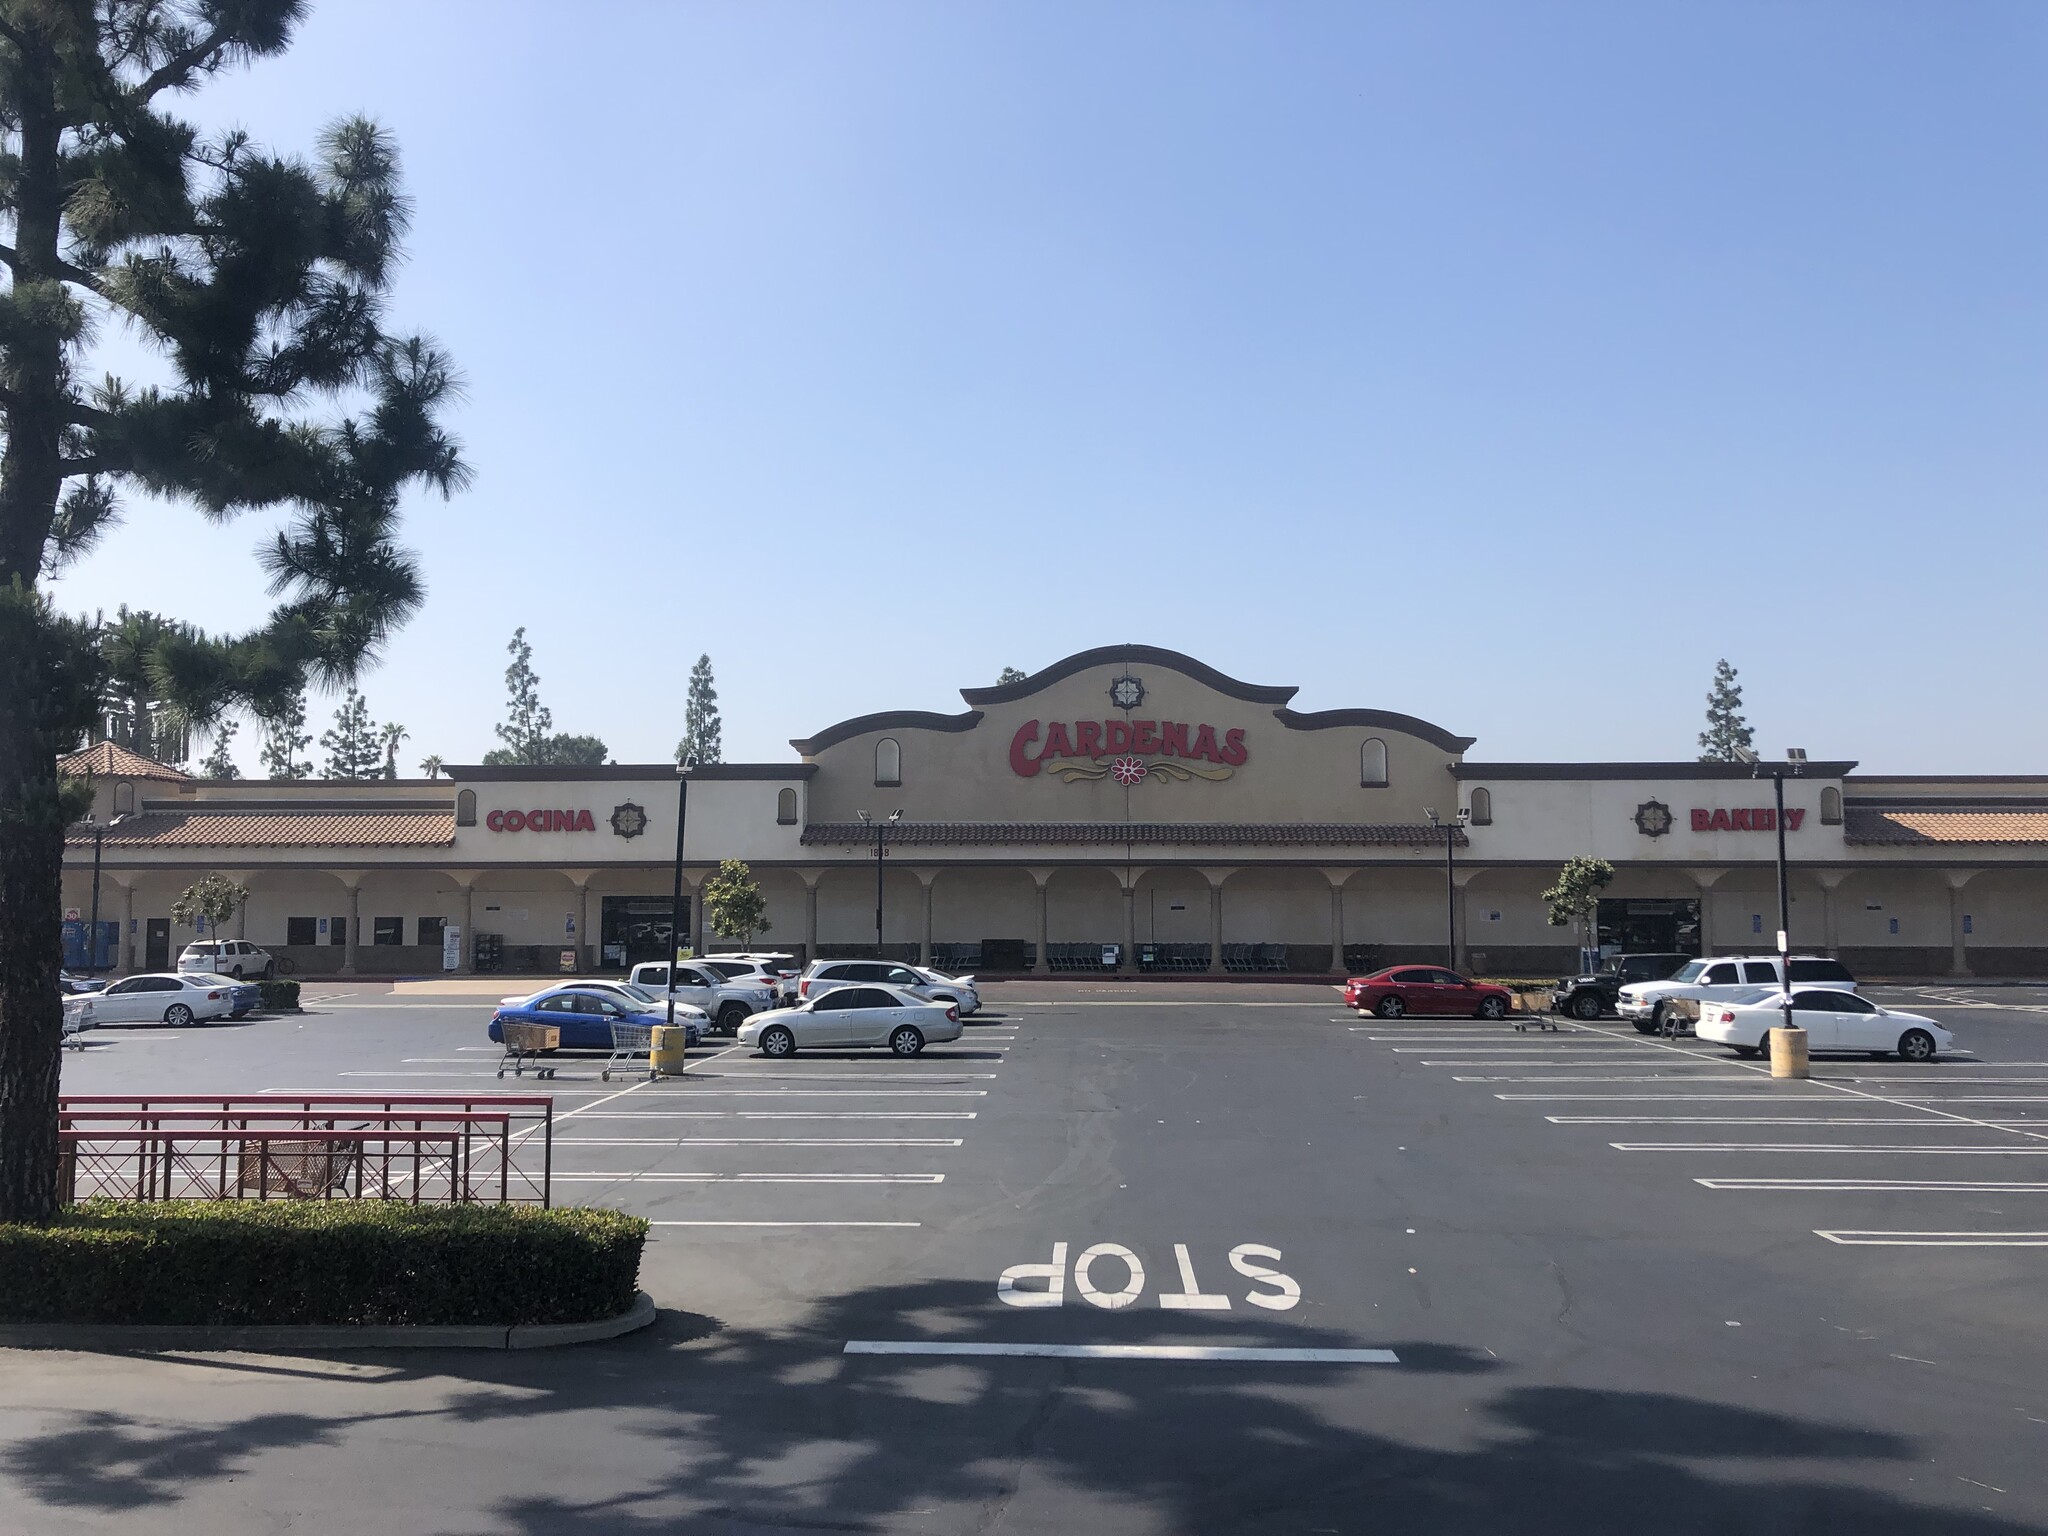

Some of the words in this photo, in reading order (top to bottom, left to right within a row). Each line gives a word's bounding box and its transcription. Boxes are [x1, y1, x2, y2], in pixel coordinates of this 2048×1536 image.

[1009, 719, 1248, 777] CARDENAS
[486, 809, 596, 832] COCINA
[997, 1241, 1302, 1311] STOP
